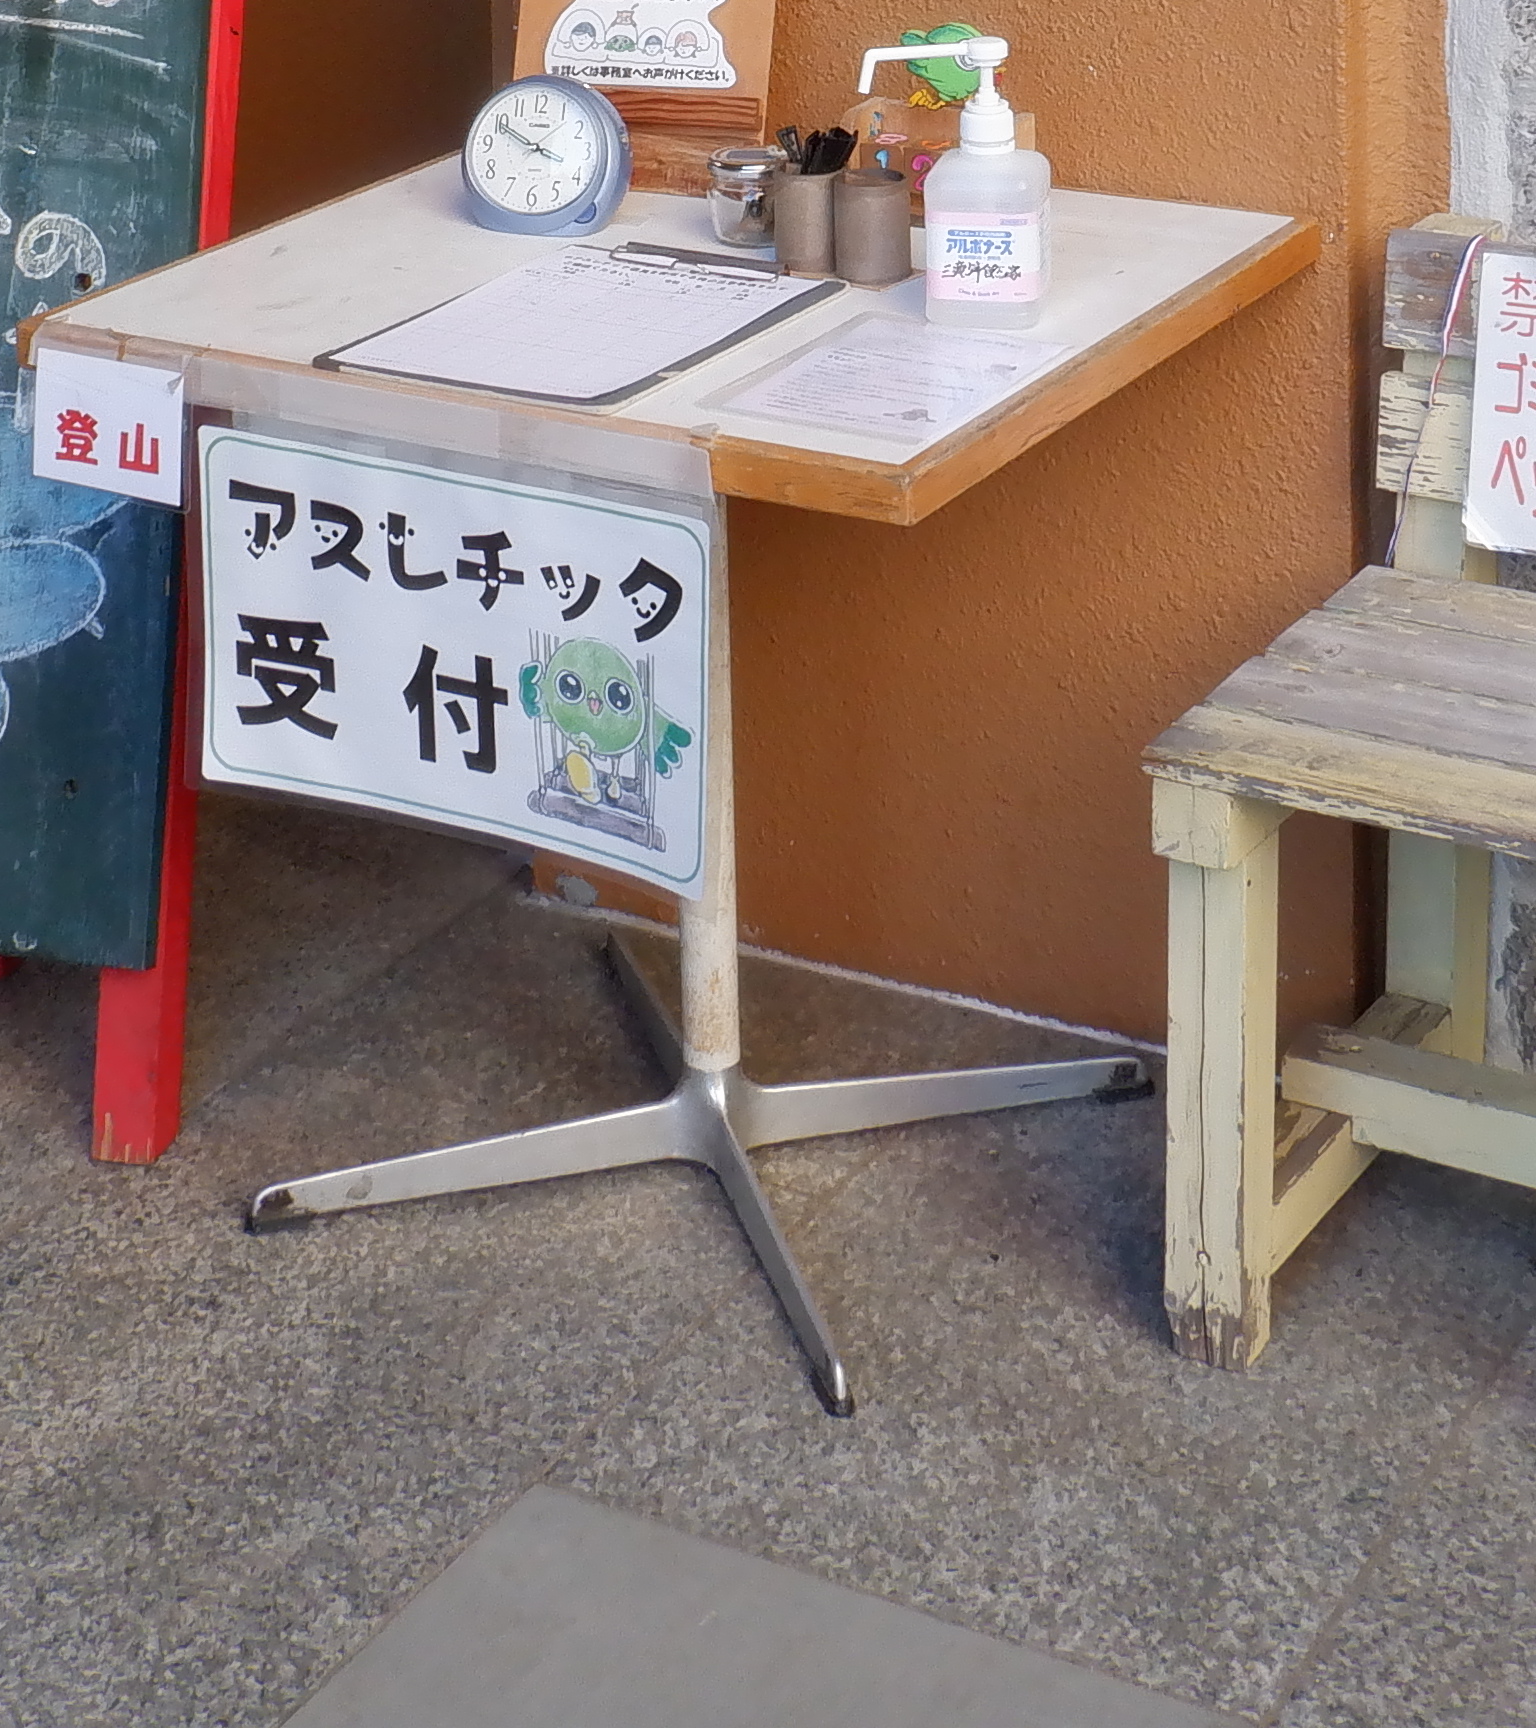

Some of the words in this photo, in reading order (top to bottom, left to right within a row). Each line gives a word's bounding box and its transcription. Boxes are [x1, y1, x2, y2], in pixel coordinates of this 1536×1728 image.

[514, 98, 524, 117] 11
[534, 94, 548, 114] 12
[561, 102, 566, 120] 1
[495, 113, 509, 135] 10
[574, 120, 584, 139] 2
[482, 135, 493, 154] 9
[583, 142, 591, 161] 3
[485, 158, 496, 180] 8
[571, 165, 582, 186] 4
[504, 177, 516, 198] 7
[526, 184, 539, 207] 6
[551, 180, 562, 202] 5
[946, 238, 1013, 255] アルボナース
[54, 409, 161, 476] 登山
[228, 478, 684, 644] アスレチック
[234, 613, 510, 775] 受付
